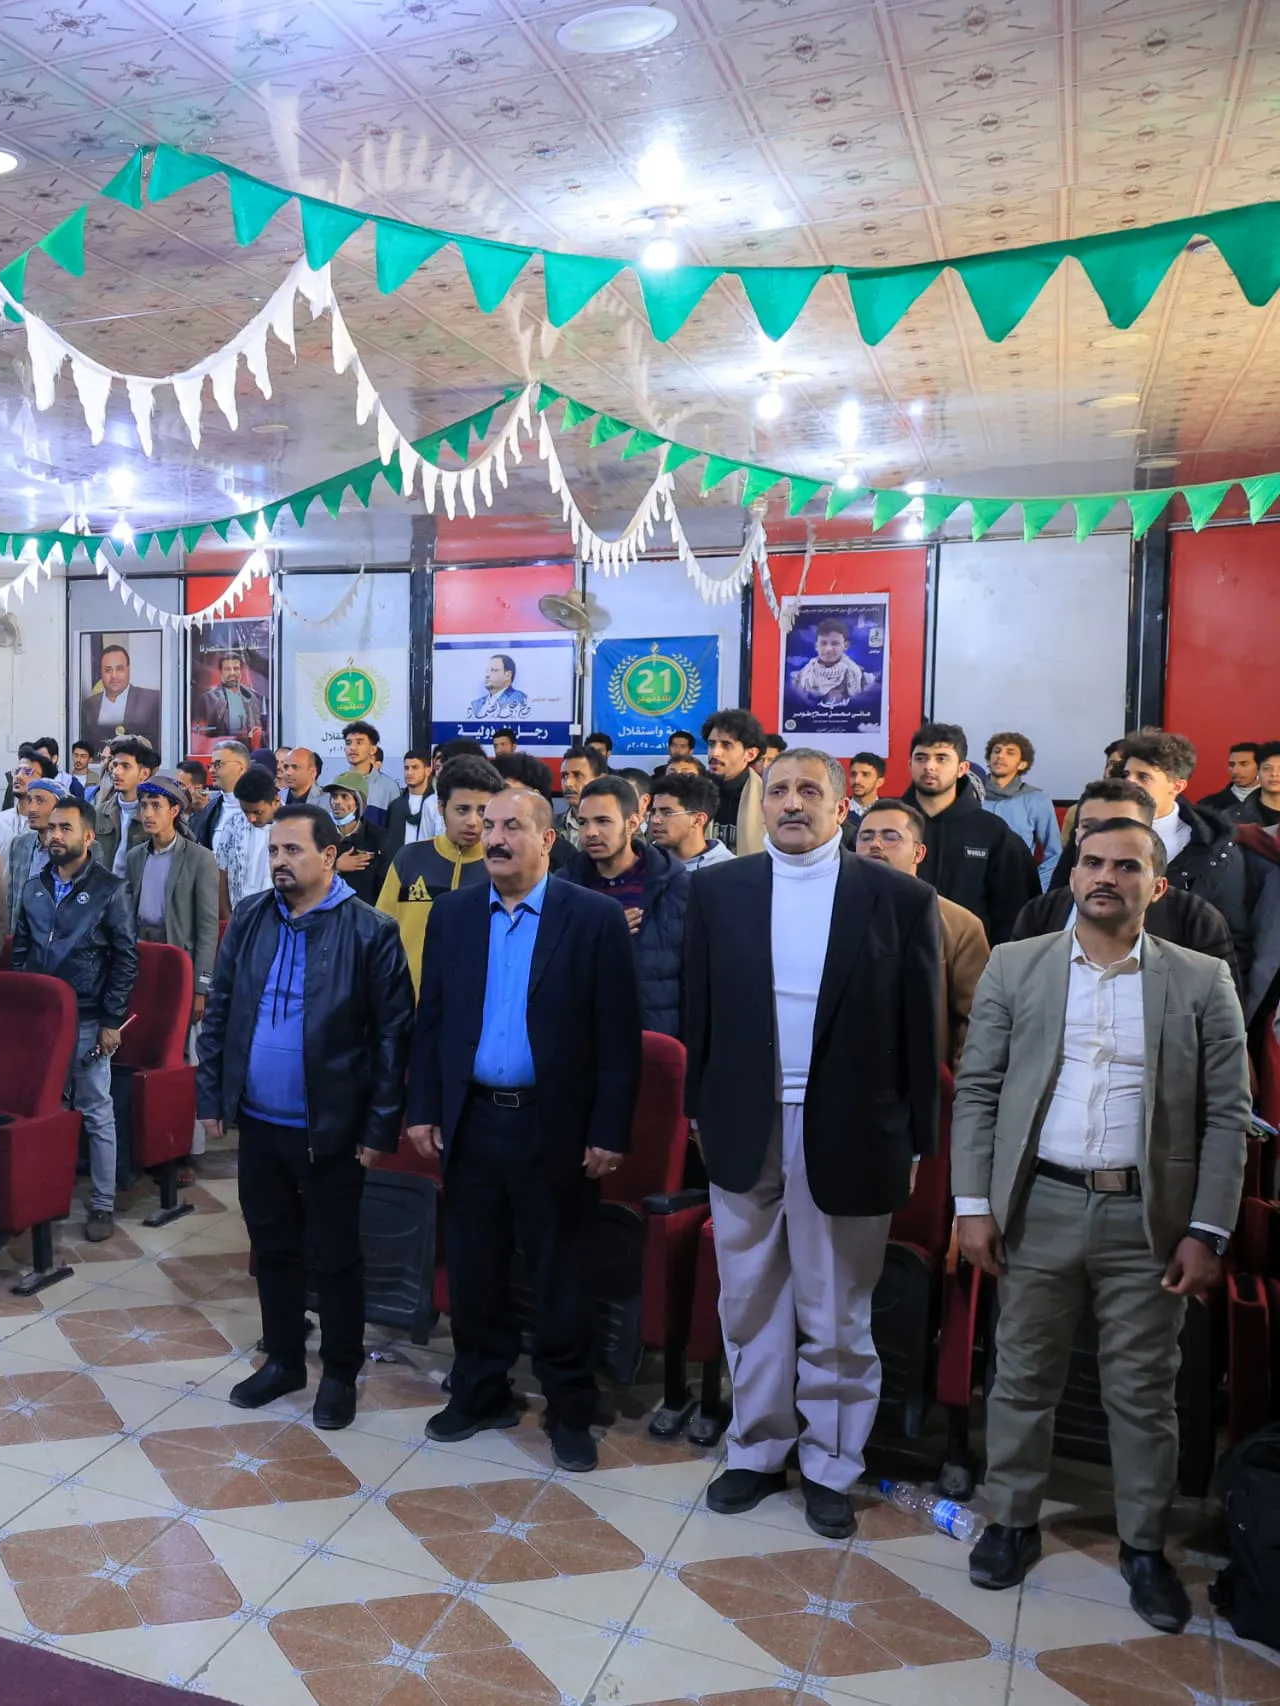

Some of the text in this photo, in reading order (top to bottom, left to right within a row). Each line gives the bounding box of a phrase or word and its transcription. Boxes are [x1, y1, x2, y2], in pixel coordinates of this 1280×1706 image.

[336, 679, 365, 702] 21
[637, 668, 671, 694] 21
[618, 726, 664, 737] واستقلال
